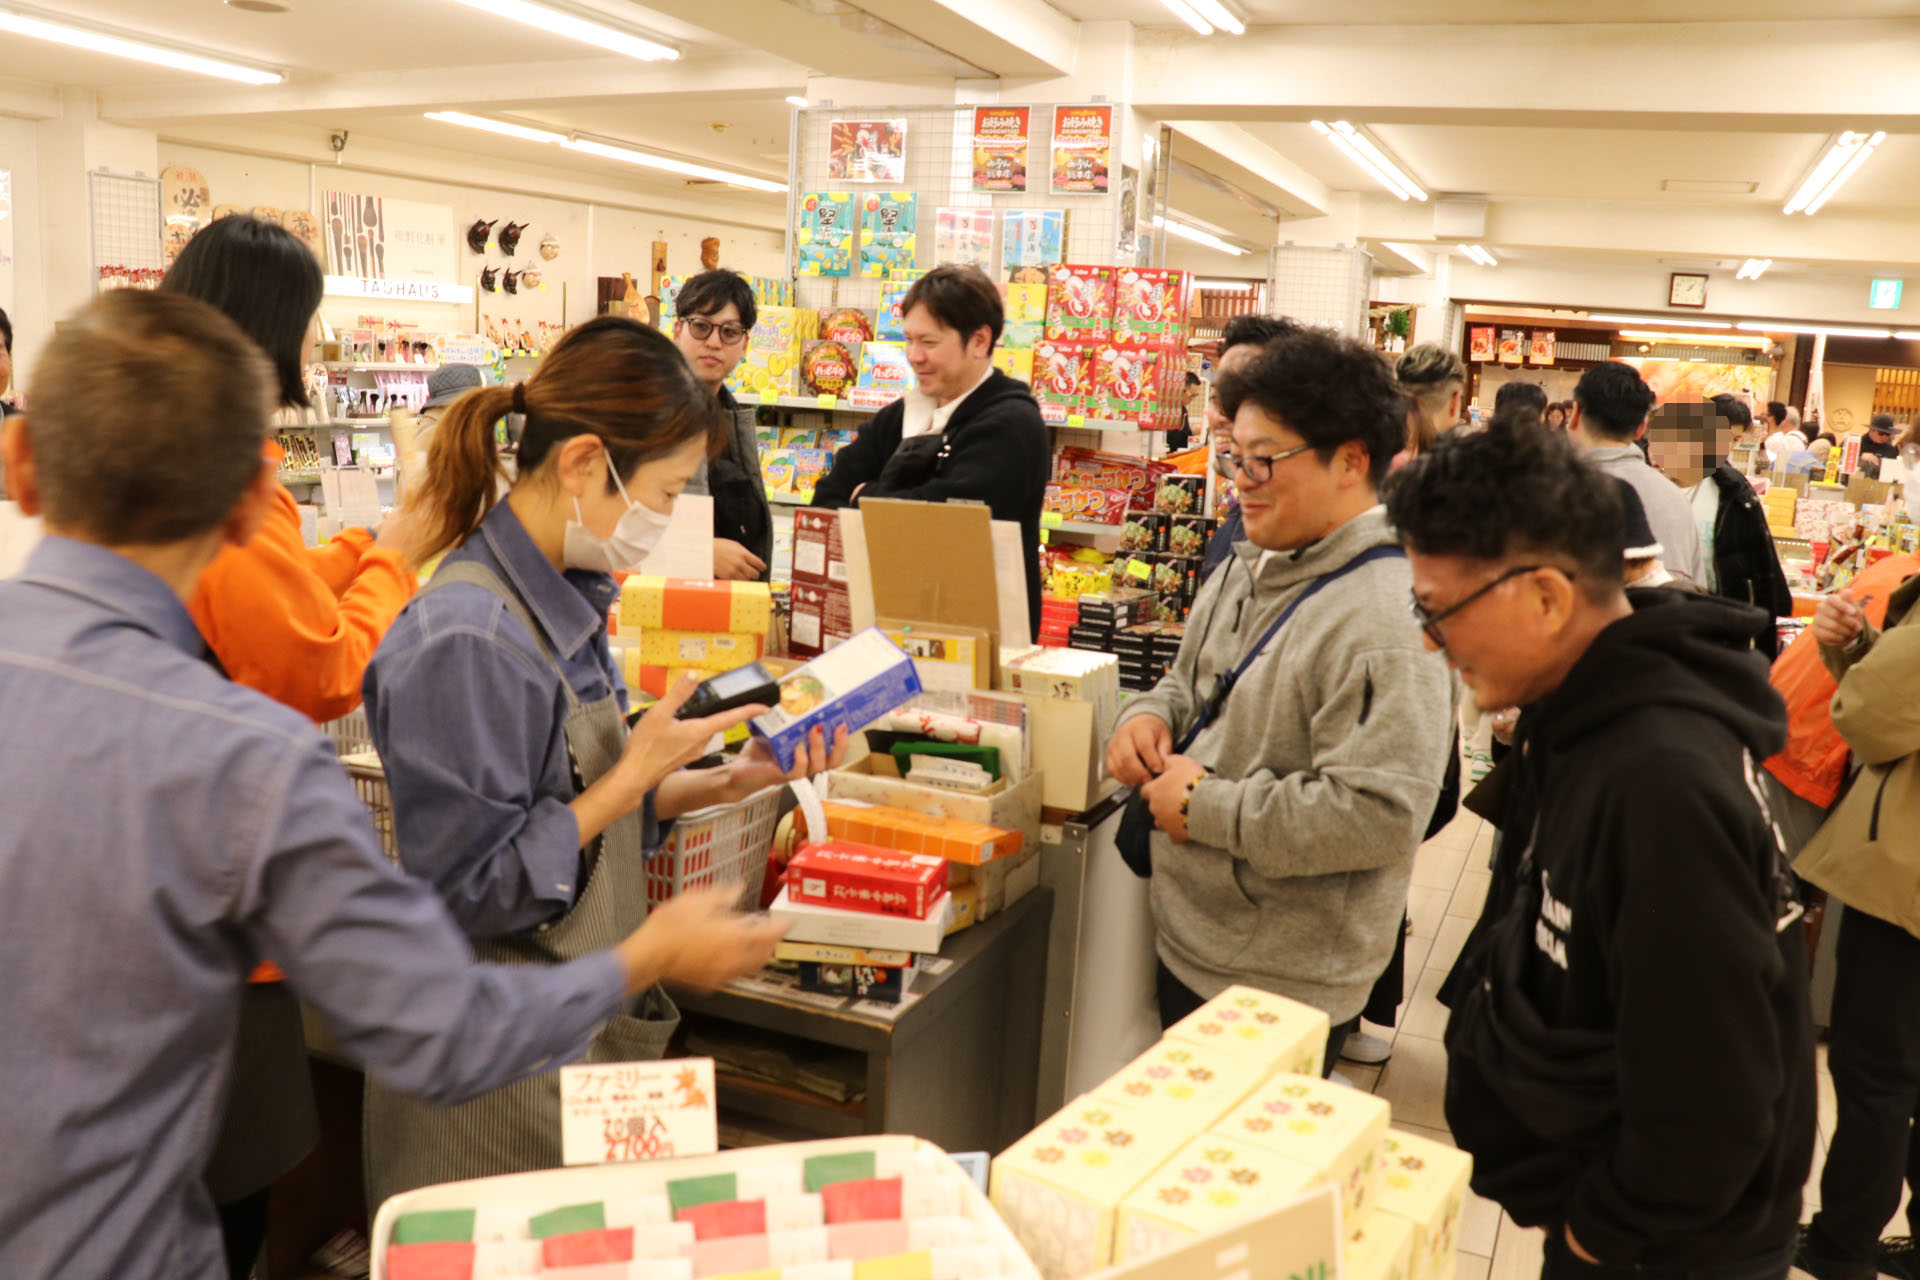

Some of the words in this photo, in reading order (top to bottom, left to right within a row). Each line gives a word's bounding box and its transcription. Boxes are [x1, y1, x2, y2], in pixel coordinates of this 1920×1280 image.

[573, 1067, 661, 1091] ファミリー
